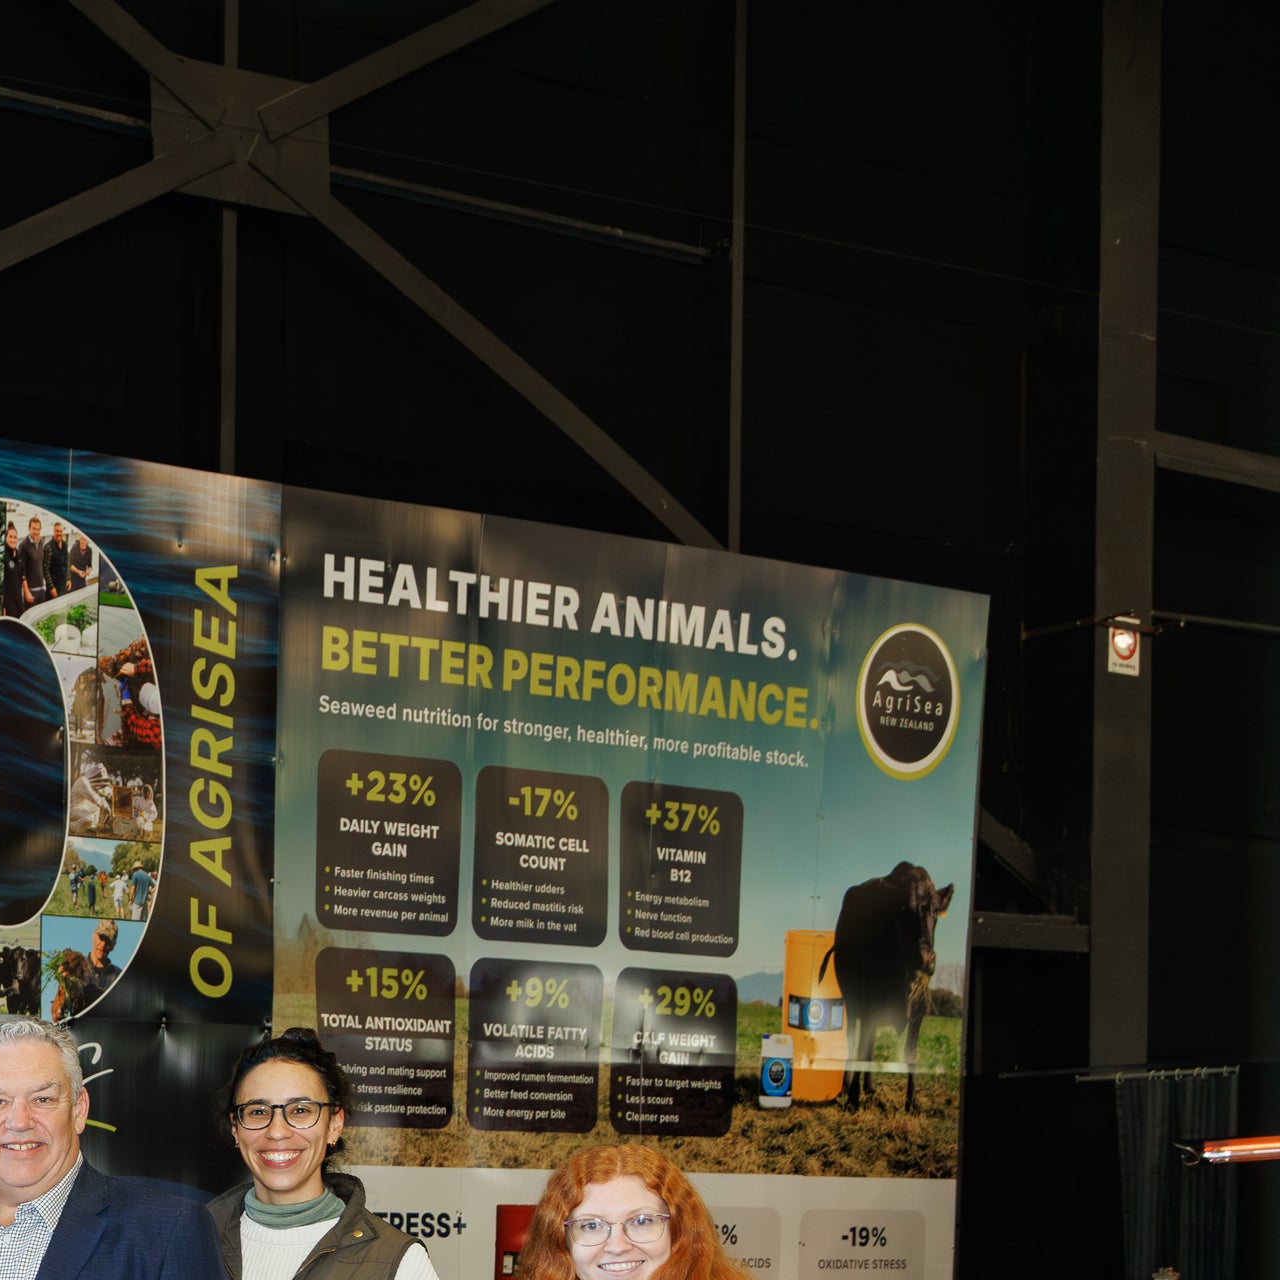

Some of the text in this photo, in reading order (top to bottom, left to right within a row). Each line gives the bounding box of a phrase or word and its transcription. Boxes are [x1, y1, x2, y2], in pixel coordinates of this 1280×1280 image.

[323, 553, 797, 661] HEALTHIER ANIMALS.
[322, 626, 820, 730] BETTER PERFORMANCE.
[872, 690, 944, 717] AgriSea
[318, 694, 809, 767] Seaweed nutrition for stronger, healthier, more profitable stock.
[879, 715, 936, 733] NEW ZEALAND
[188, 564, 239, 999] OF AGRISEA
[346, 770, 436, 806] +23%
[508, 786, 578, 821] -17%
[339, 817, 439, 839] DAILY WEIGHT
[646, 801, 721, 836] +37%
[371, 842, 407, 858] GAIN
[495, 831, 590, 853] SOMATIC CELL
[519, 854, 566, 871] COUNT
[657, 847, 706, 865] VITAMIN
[671, 869, 691, 883] B12
[346, 967, 428, 1001] +15%
[506, 977, 570, 1008] +9%
[321, 1013, 452, 1034] TOTAL ANTIOXIDANT
[483, 1023, 587, 1042] VOLATILE FATTY
[365, 1037, 413, 1052] STATUS
[515, 1044, 554, 1060] ACIDS
[841, 1226, 887, 1247] -19%
[818, 1259, 907, 1270] OXIDATIVE STRESS
